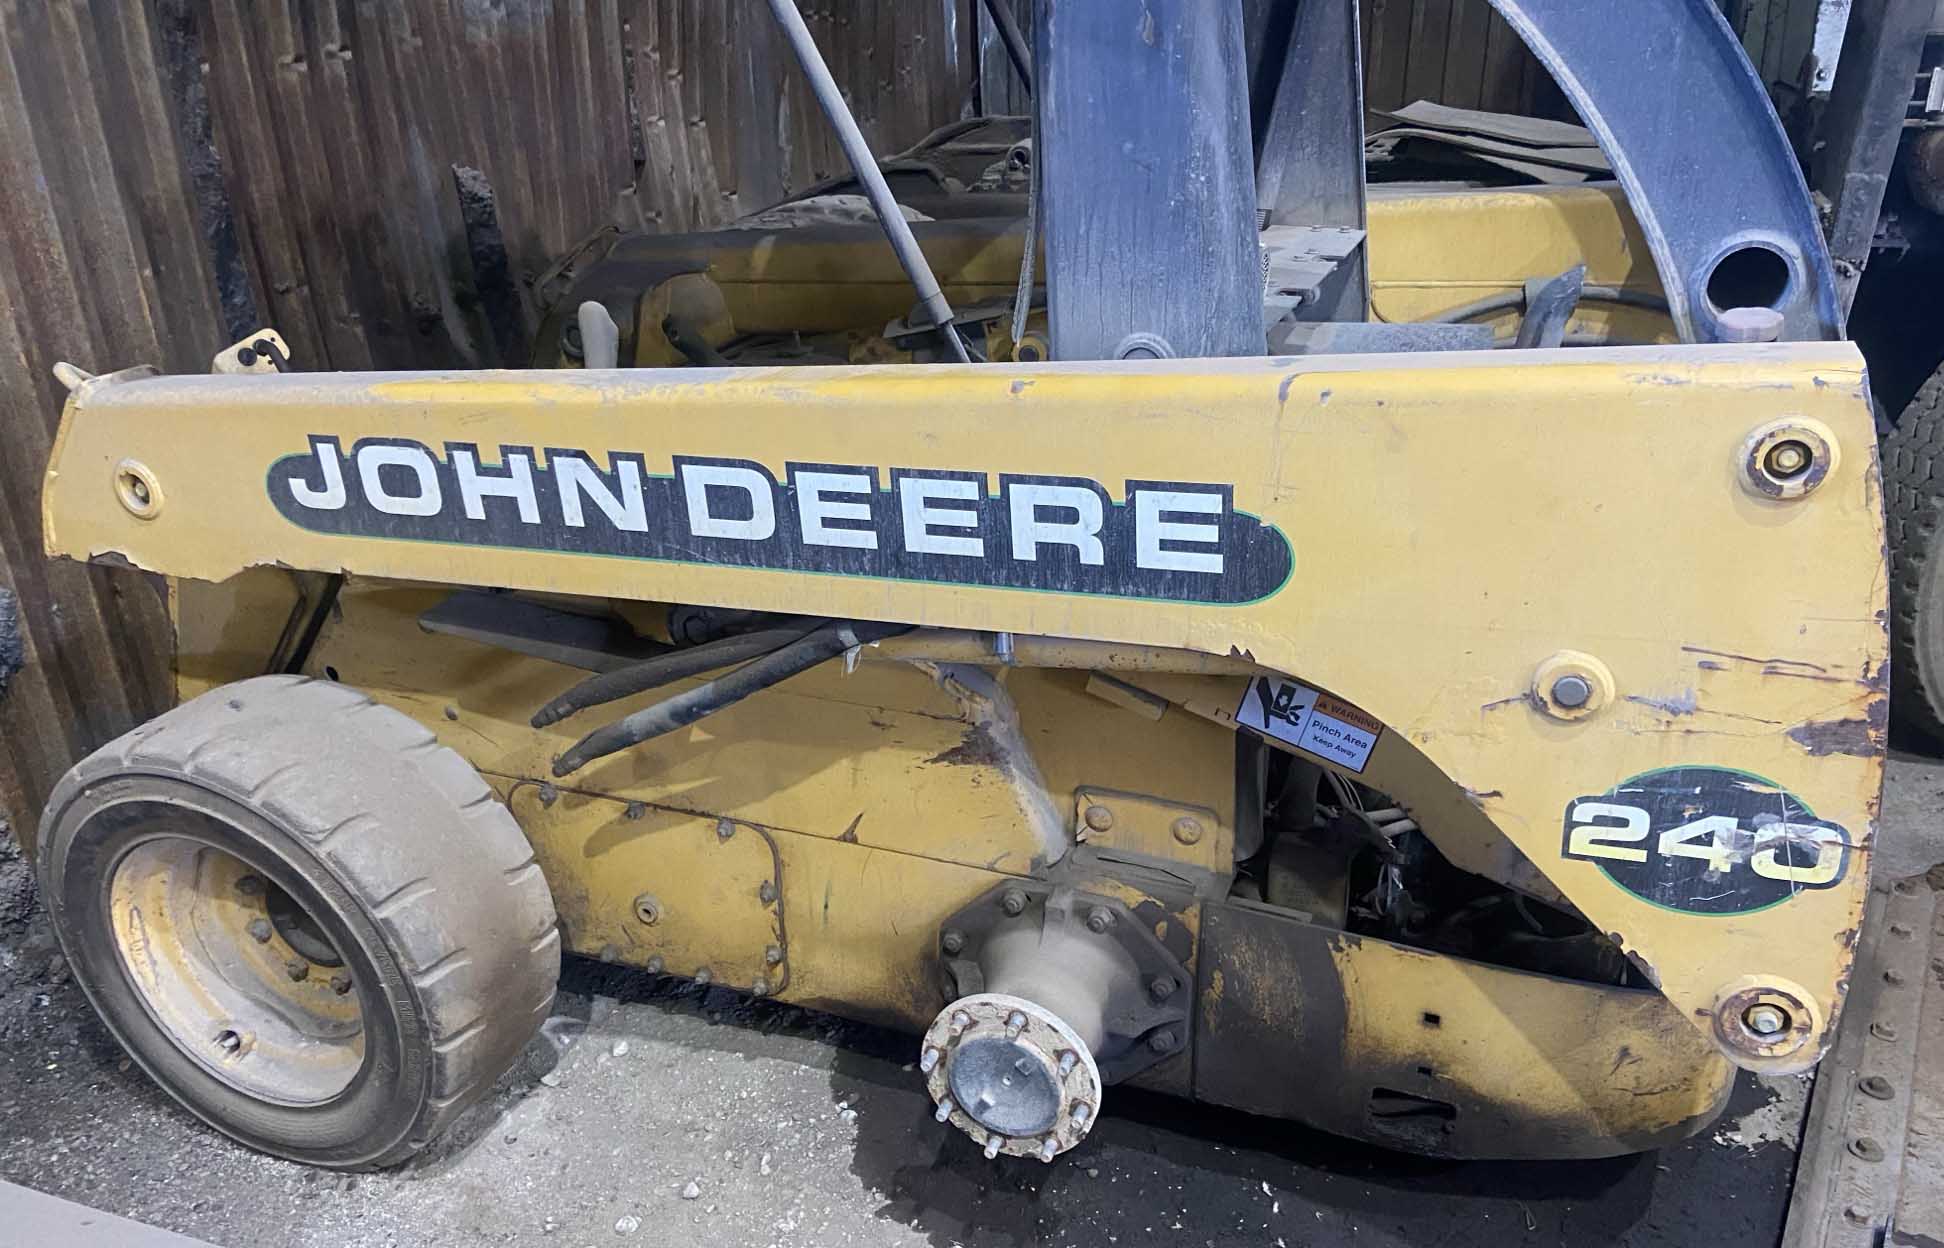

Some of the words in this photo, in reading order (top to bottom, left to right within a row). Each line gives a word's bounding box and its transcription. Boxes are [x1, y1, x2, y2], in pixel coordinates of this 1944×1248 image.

[288, 443, 648, 532] JOHN
[681, 464, 1223, 573] DEERE
[1331, 704, 1379, 730] WARNING
[1312, 720, 1341, 737] Pinch
[1343, 733, 1368, 749] Area
[1313, 735, 1333, 748] Keep
[1334, 744, 1356, 758] Away
[1569, 802, 1843, 883] 240
